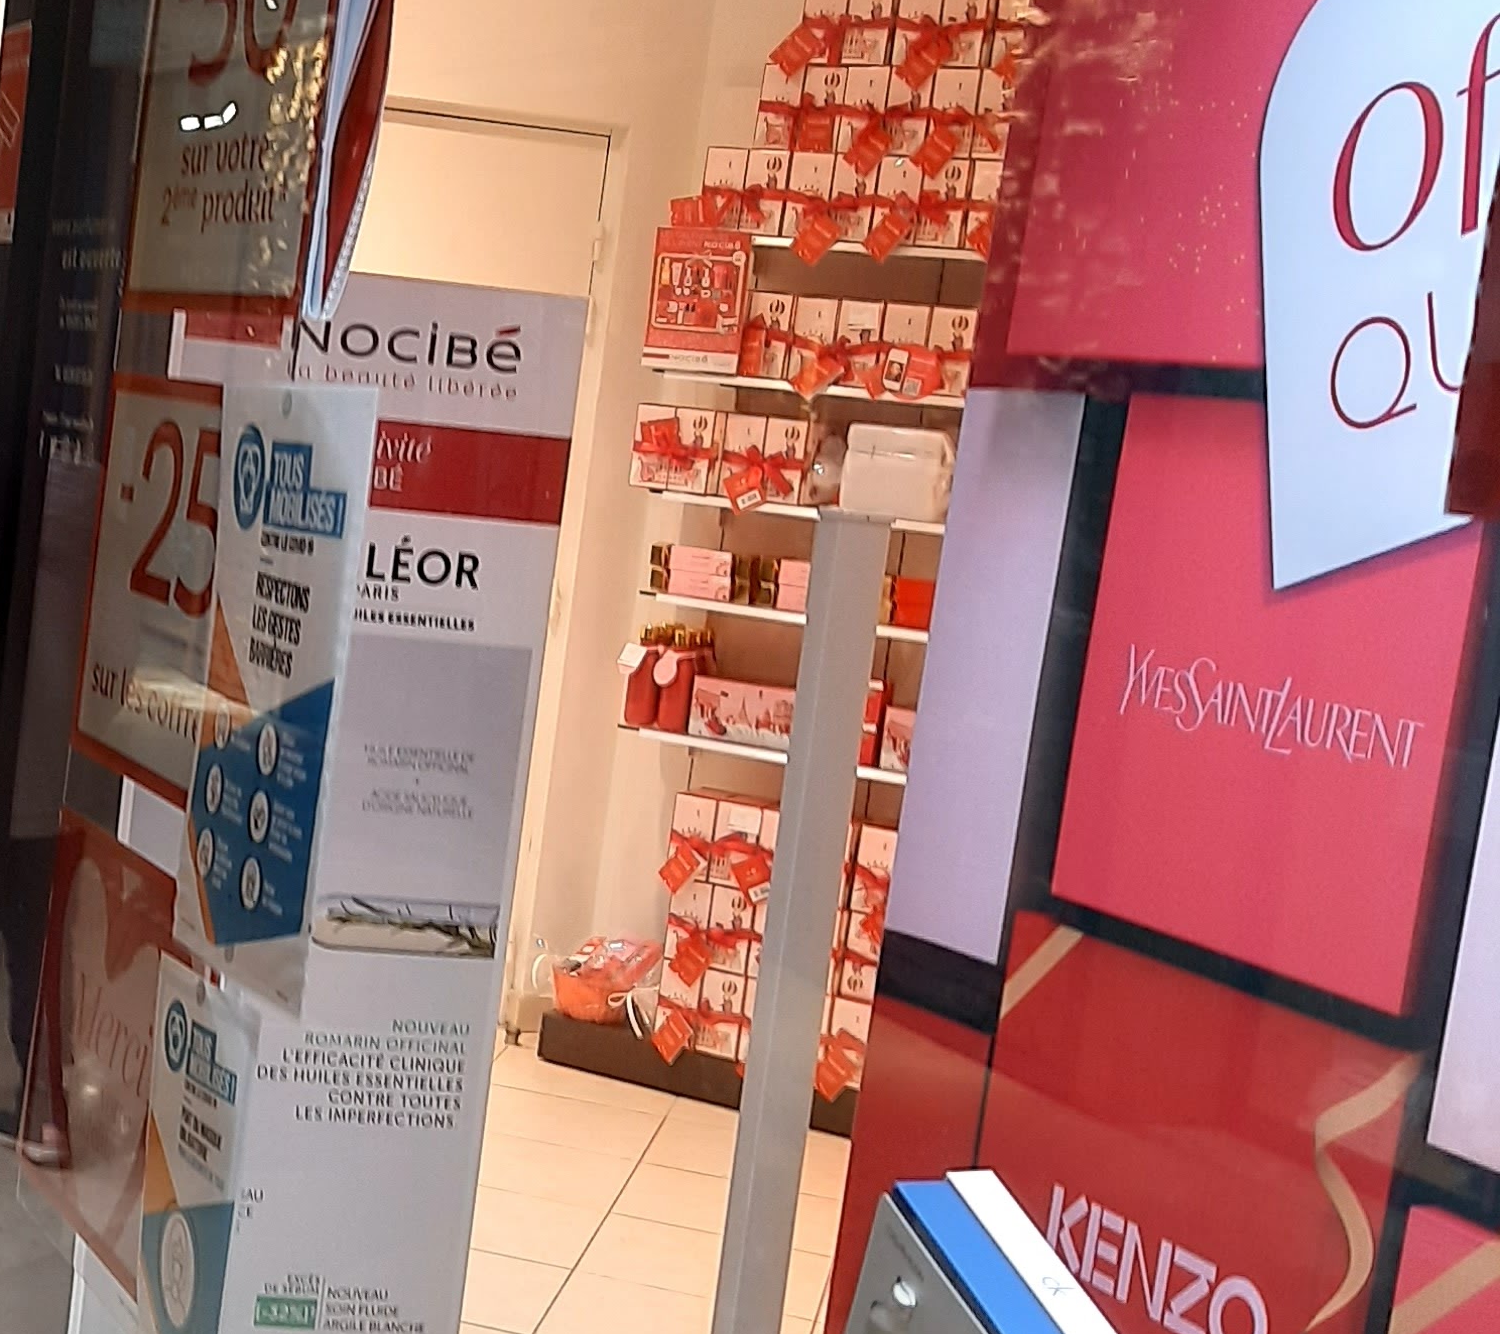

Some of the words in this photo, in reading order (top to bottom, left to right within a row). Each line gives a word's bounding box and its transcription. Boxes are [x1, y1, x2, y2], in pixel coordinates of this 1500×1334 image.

[181, 142, 212, 176] sur
[273, 451, 305, 489] TOUS
[392, 1019, 470, 1036] NOUVEAU
[304, 1031, 380, 1050] ROMARIN
[389, 1056, 465, 1074] CLINIQUE
[256, 1065, 288, 1081] DES
[293, 1067, 350, 1085] HUILES
[355, 1072, 464, 1092] ESSENTIELLES
[328, 1089, 393, 1107] CONTRE
[401, 1094, 461, 1111] TOUTES
[295, 1105, 322, 1121] LES
